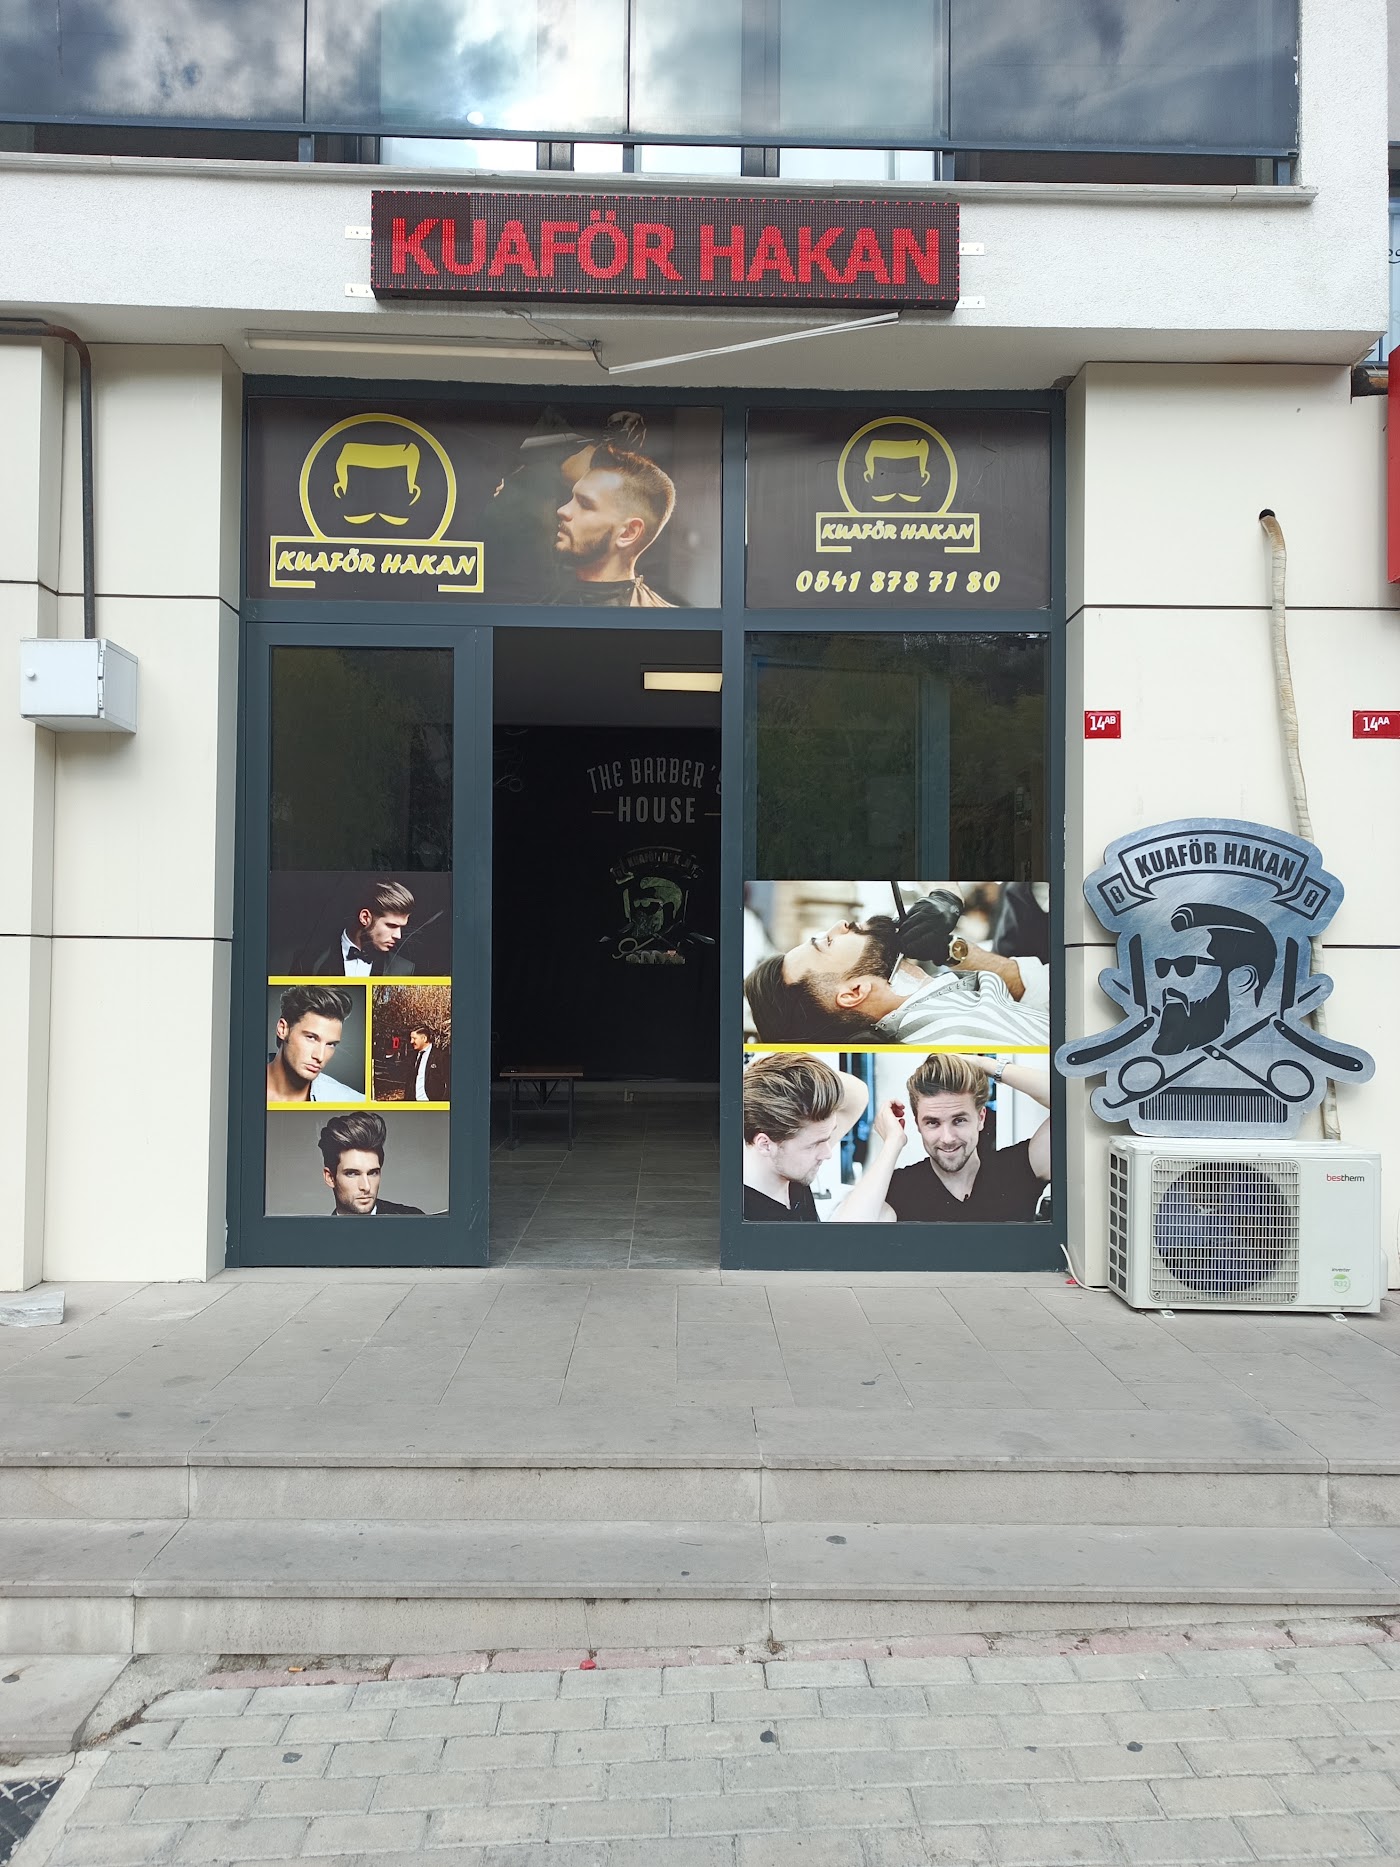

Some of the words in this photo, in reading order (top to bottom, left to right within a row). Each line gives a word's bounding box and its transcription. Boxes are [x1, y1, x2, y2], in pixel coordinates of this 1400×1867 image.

[391, 211, 682, 281] KUAFÖR
[700, 225, 940, 285] HAKAN
[822, 520, 897, 540] KUAFÖR
[899, 523, 974, 540] HAKAN
[277, 548, 376, 573] KUAFÖR
[380, 553, 477, 575] HAKAN
[795, 570, 862, 592] 0541
[869, 570, 920, 593] 878
[928, 571, 958, 593] 71
[966, 571, 1001, 593] 80
[586, 760, 624, 794] THE
[618, 796, 696, 824] HOUSE
[1134, 838, 1218, 880] KUAFÖR
[1223, 842, 1297, 882] HAKAN
[1326, 1173, 1365, 1182] bestherm
